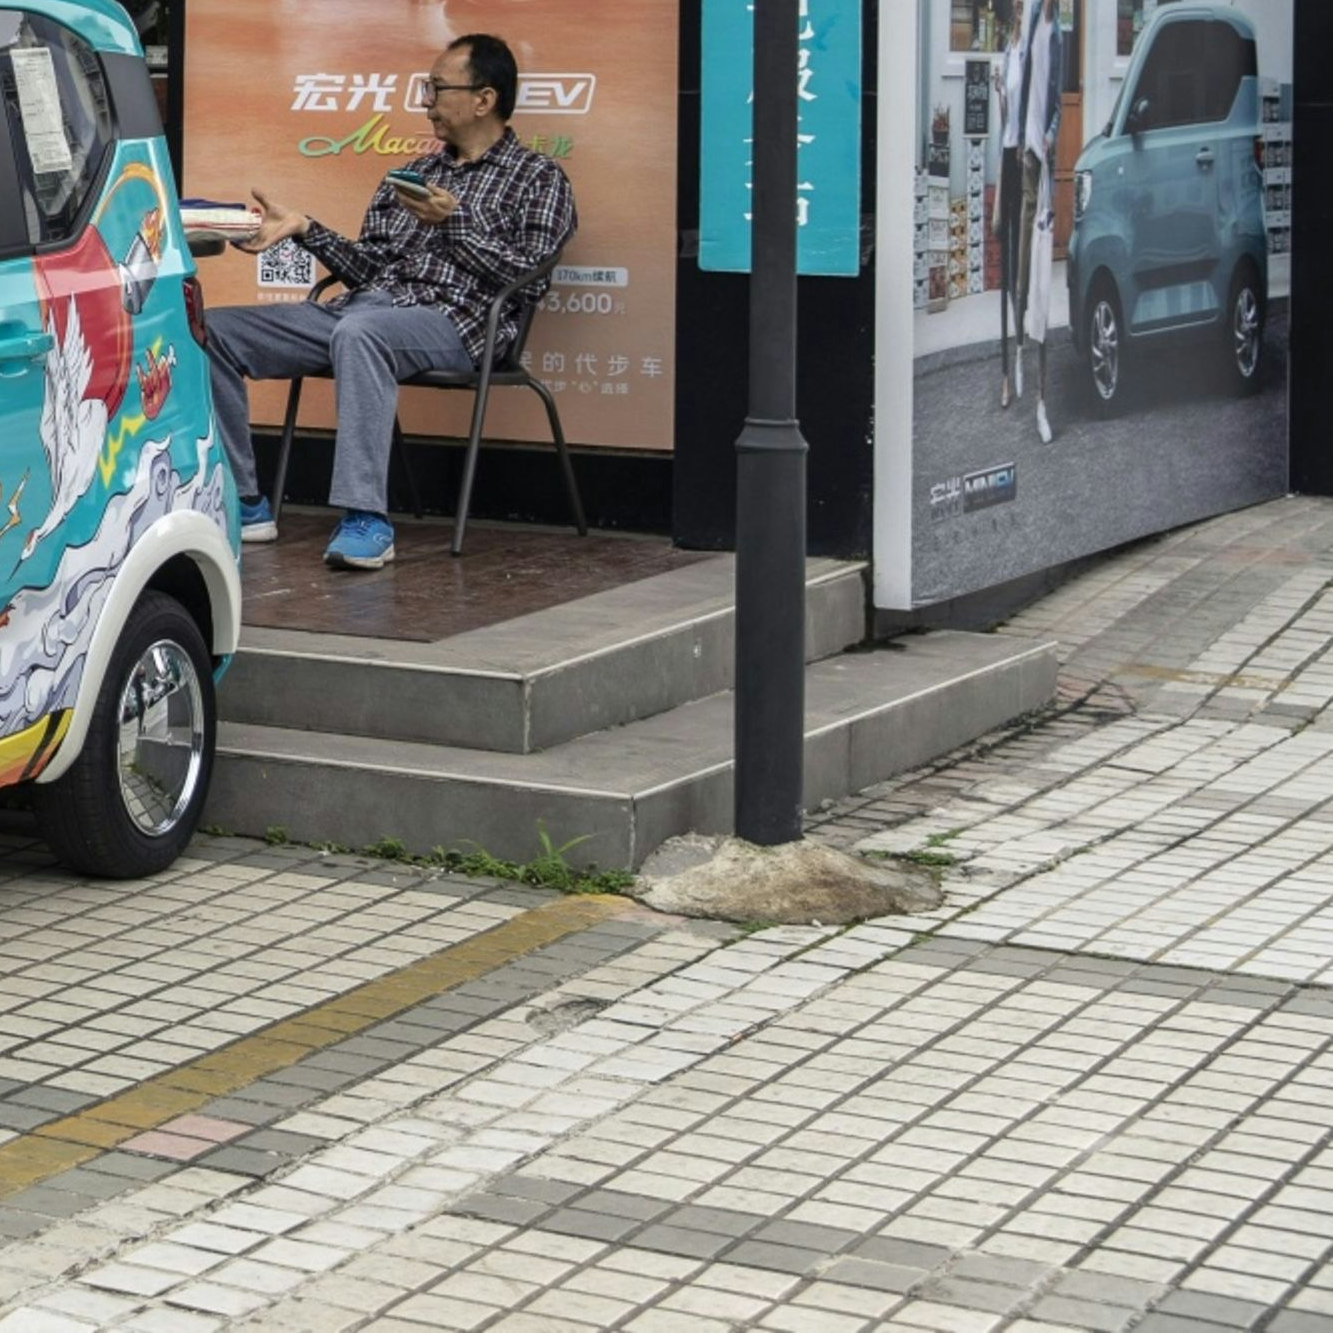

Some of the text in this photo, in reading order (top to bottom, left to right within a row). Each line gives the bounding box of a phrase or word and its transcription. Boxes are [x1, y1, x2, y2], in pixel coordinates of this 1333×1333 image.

[291, 72, 397, 112] 宏光
[298, 114, 445, 157] Macar
[518, 352, 663, 377] 民的代步车
